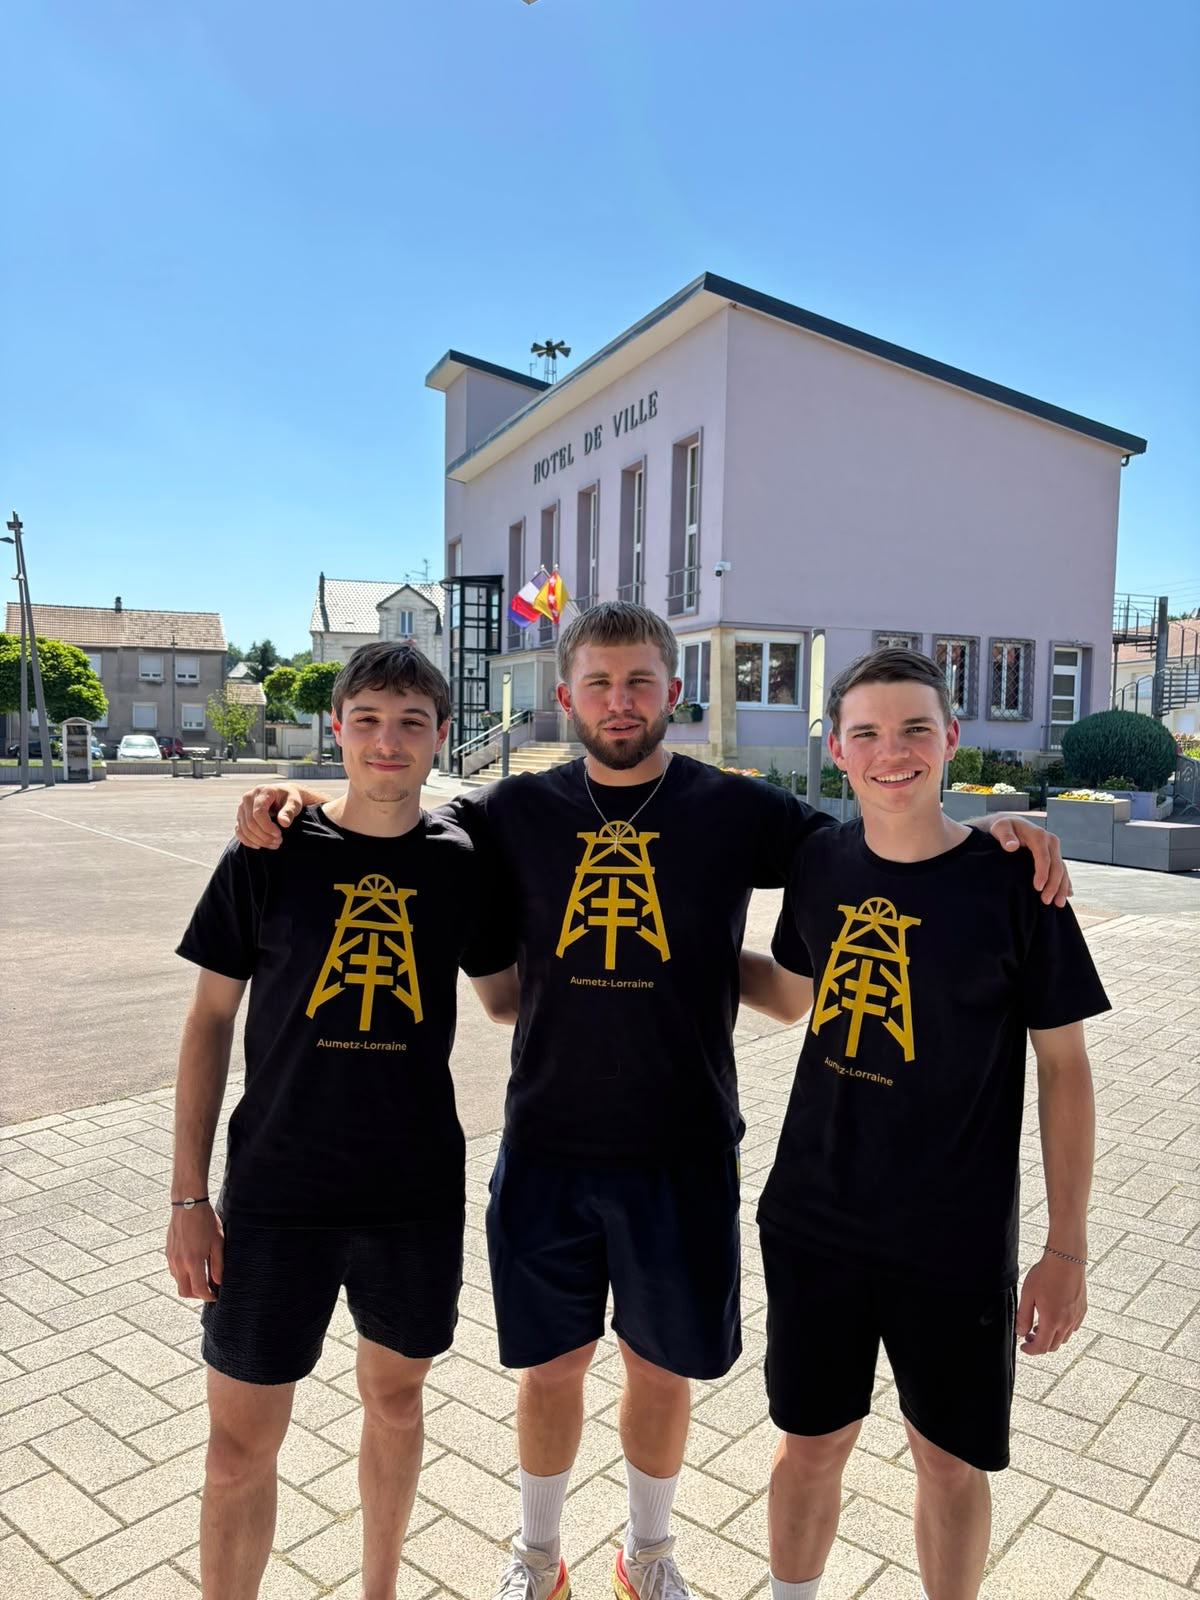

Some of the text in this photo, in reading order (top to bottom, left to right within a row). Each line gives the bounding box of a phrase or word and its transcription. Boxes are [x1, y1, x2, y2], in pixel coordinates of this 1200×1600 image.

[533, 390, 658, 485] HOTEL DE VILLE
[570, 976, 655, 988] Aumetz-Lorraine
[316, 1038, 407, 1051] Aumetz-Lorraine
[824, 1056, 894, 1087] Aumtz-Lorraine
